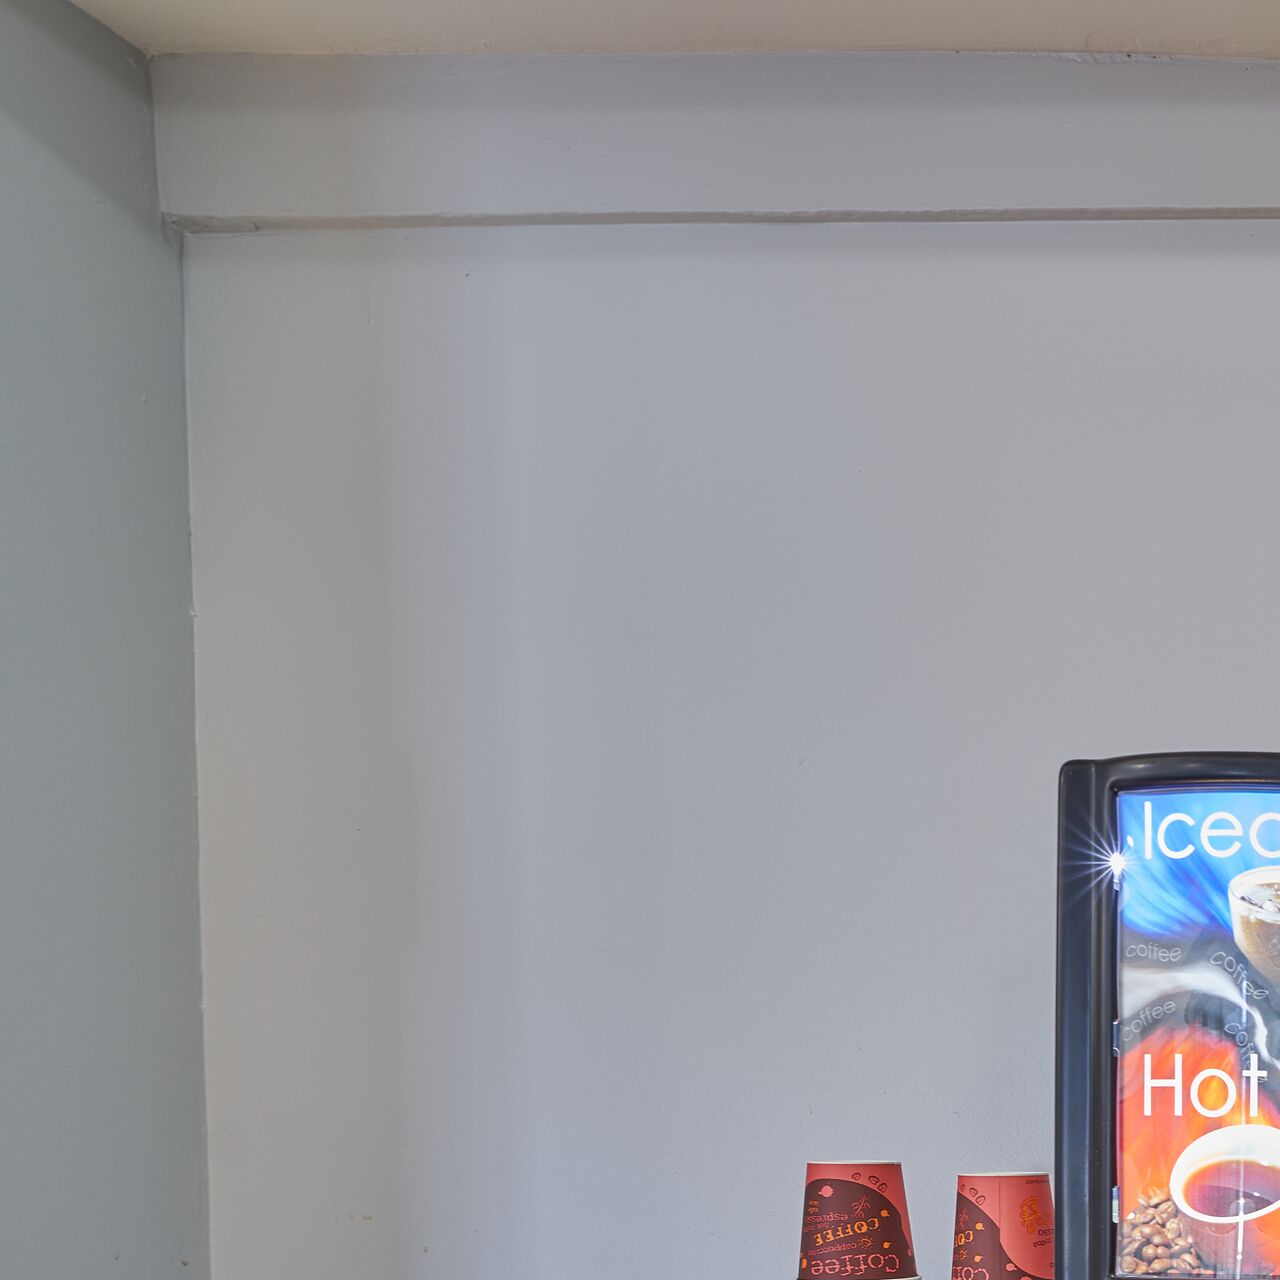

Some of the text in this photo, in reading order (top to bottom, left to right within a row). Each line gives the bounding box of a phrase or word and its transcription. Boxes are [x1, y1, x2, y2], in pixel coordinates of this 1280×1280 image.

[1126, 943, 1182, 962] coffee
[1210, 951, 1269, 999] coffee
[1123, 1001, 1176, 1041] coffee
[1143, 1053, 1268, 1118] Hot
[813, 1217, 880, 1246] COFFEE
[811, 1253, 900, 1276] Coffee
